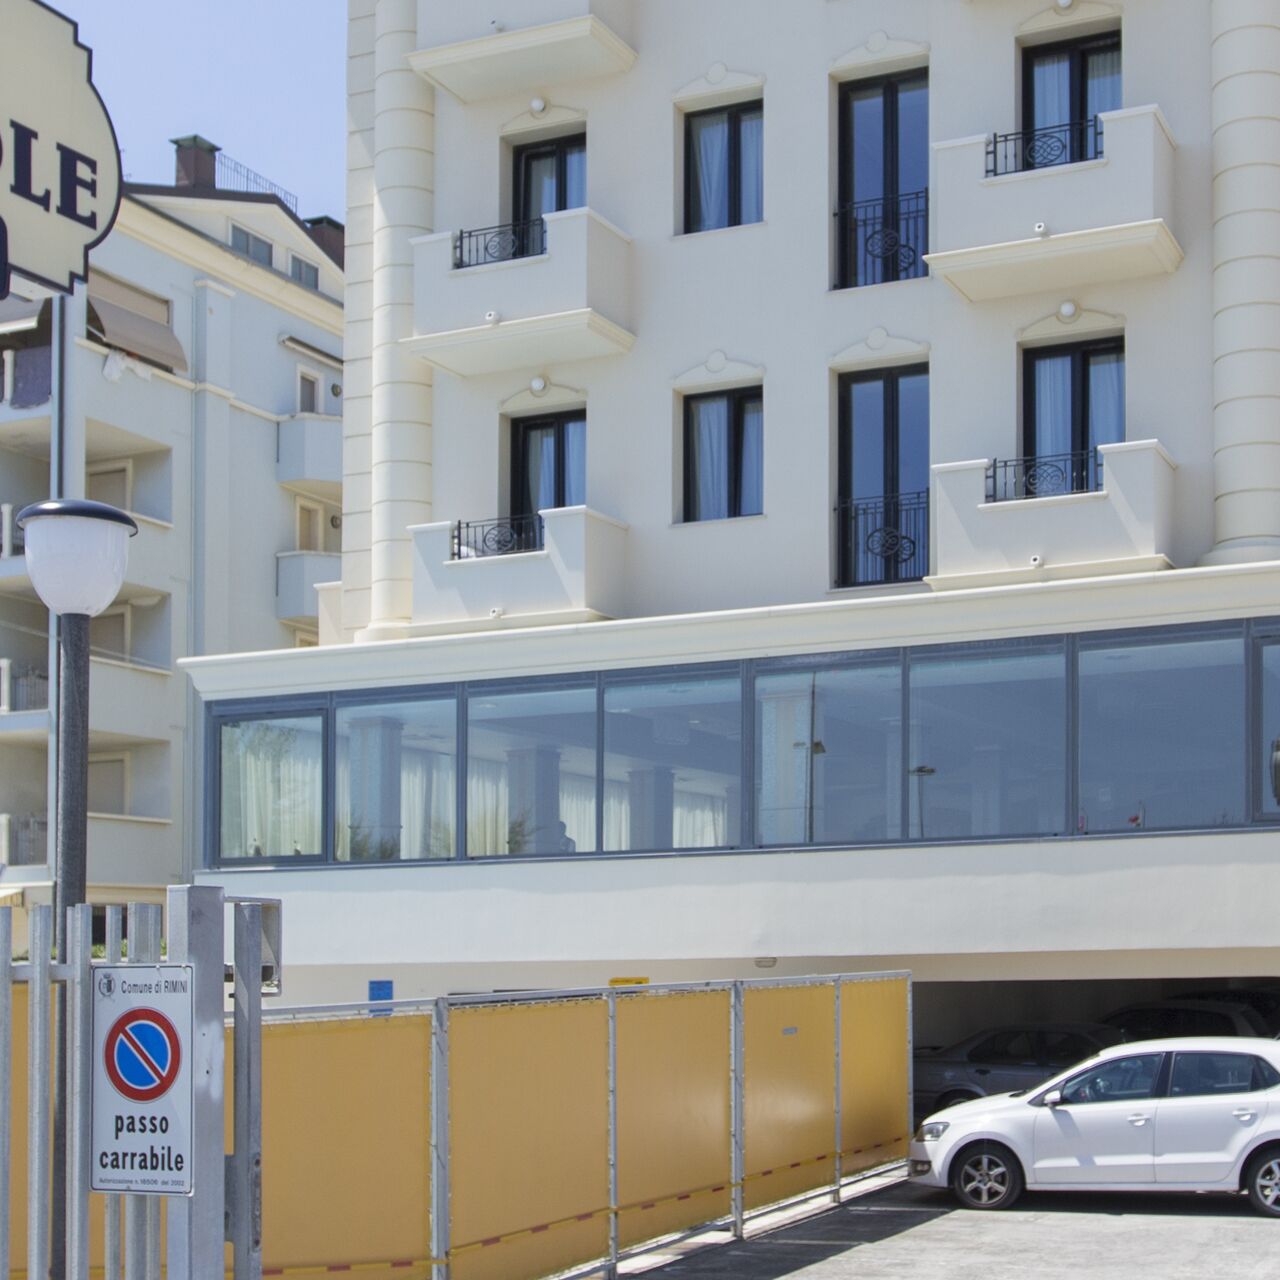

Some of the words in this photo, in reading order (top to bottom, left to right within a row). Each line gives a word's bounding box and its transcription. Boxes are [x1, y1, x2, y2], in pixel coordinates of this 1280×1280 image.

[121, 980, 152, 994] Comune
[154, 979, 162, 994] di
[164, 980, 188, 993] RIMINI
[114, 1114, 169, 1140] passo
[99, 1145, 184, 1171] carrabile
